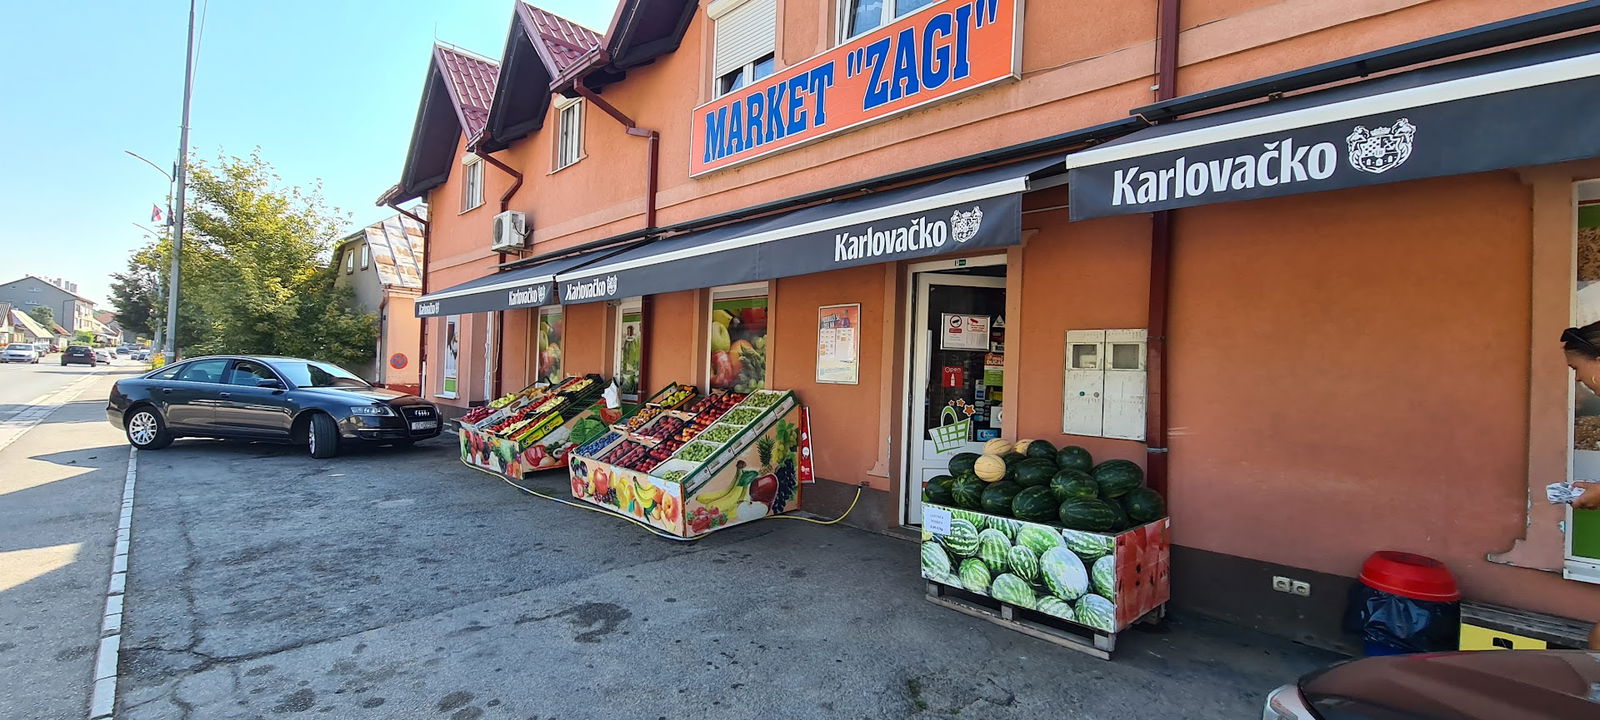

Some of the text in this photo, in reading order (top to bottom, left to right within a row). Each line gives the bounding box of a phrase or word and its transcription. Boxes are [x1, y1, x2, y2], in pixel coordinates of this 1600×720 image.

[703, 0, 999, 164] MARKET "ZAGI"
[1111, 137, 1338, 206] Karlovačko
[834, 216, 947, 262] Karlovačko
[565, 277, 606, 301] Karlovačko
